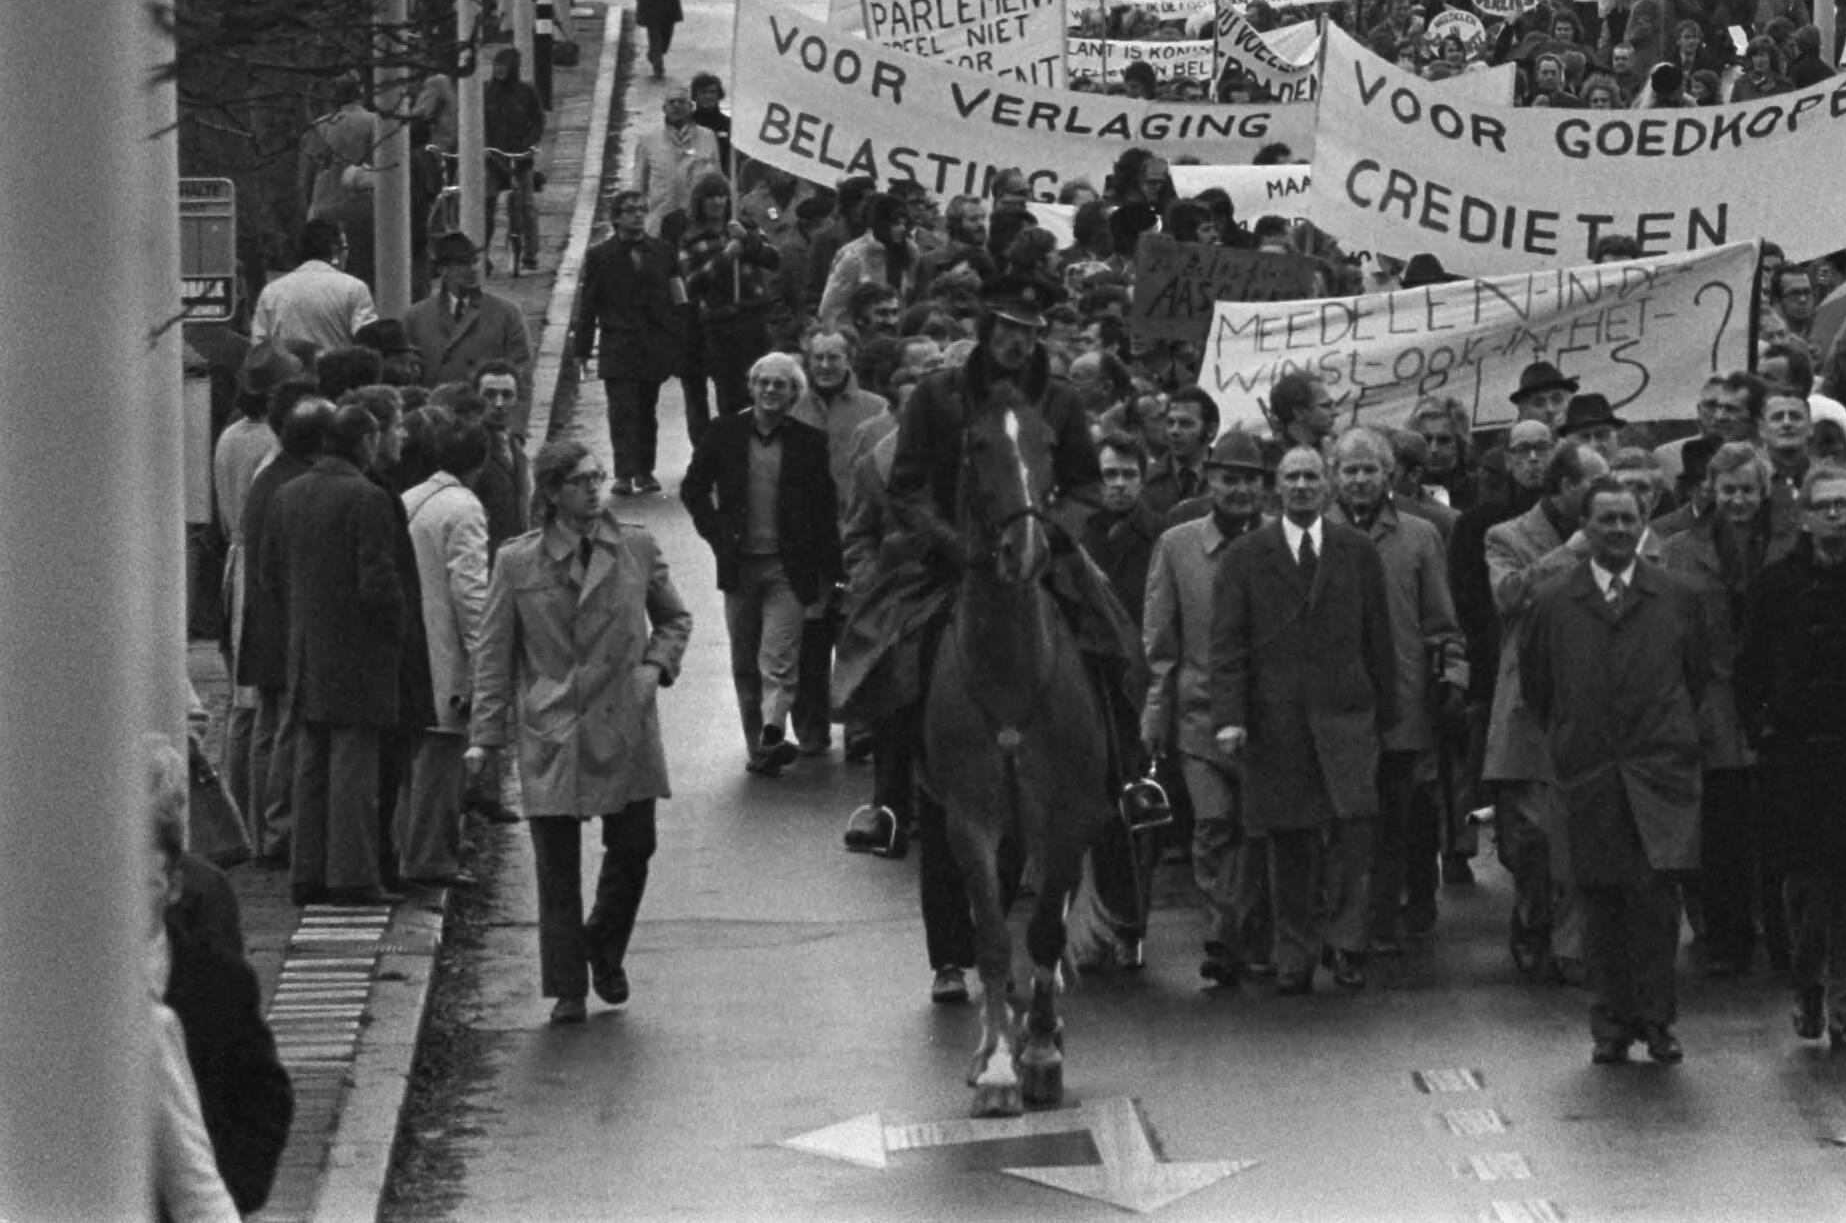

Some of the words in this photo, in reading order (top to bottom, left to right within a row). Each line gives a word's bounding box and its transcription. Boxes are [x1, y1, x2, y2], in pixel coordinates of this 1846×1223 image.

[967, 13, 1028, 48] NIET
[1067, 41, 1114, 58] LANT
[1125, 45, 1142, 59] IS
[768, 15, 907, 105] VOOR
[950, 80, 1272, 142] VERLAGING
[1174, 60, 1209, 76] BEL
[1354, 59, 1507, 153] VOOR
[1344, 158, 1728, 257] CREDIETEN
